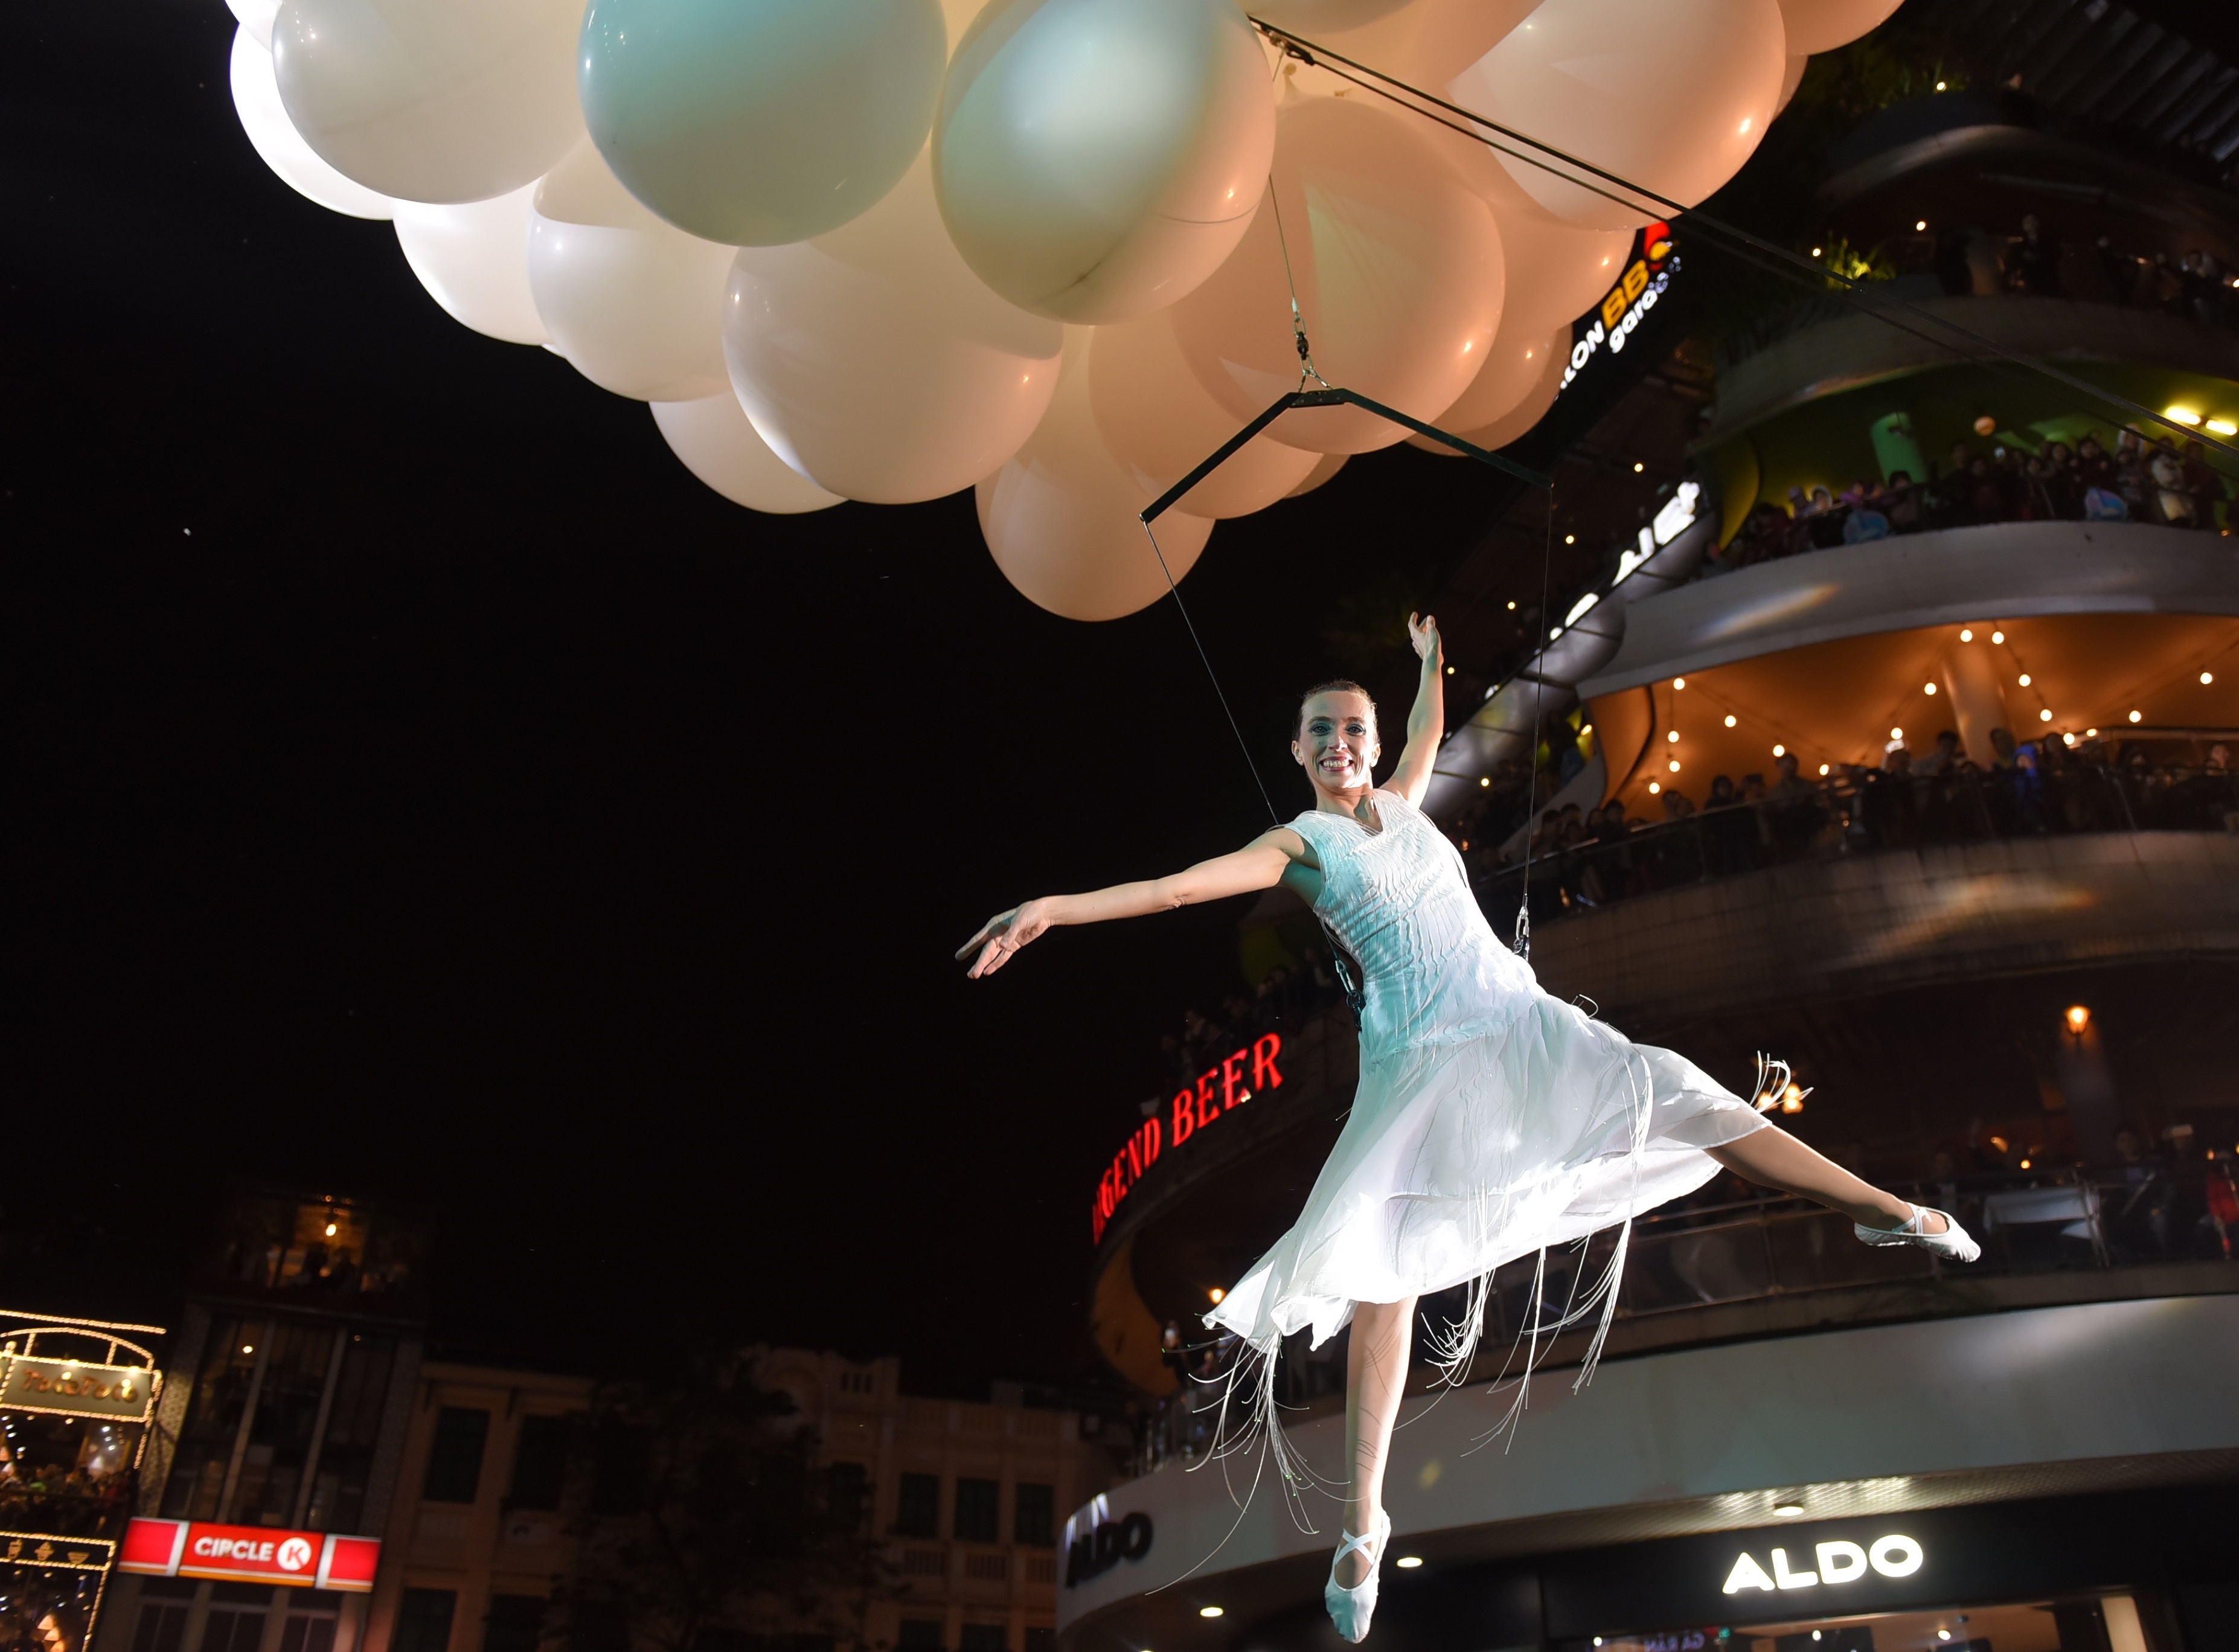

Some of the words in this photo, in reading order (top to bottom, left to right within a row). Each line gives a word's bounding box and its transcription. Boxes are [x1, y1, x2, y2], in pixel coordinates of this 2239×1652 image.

[1172, 1032, 1283, 1147] BEER
[194, 1536, 275, 1562] CIRCLE
[1065, 1512, 1153, 1588] ALDO
[1723, 1534, 1923, 1594] ALDO
